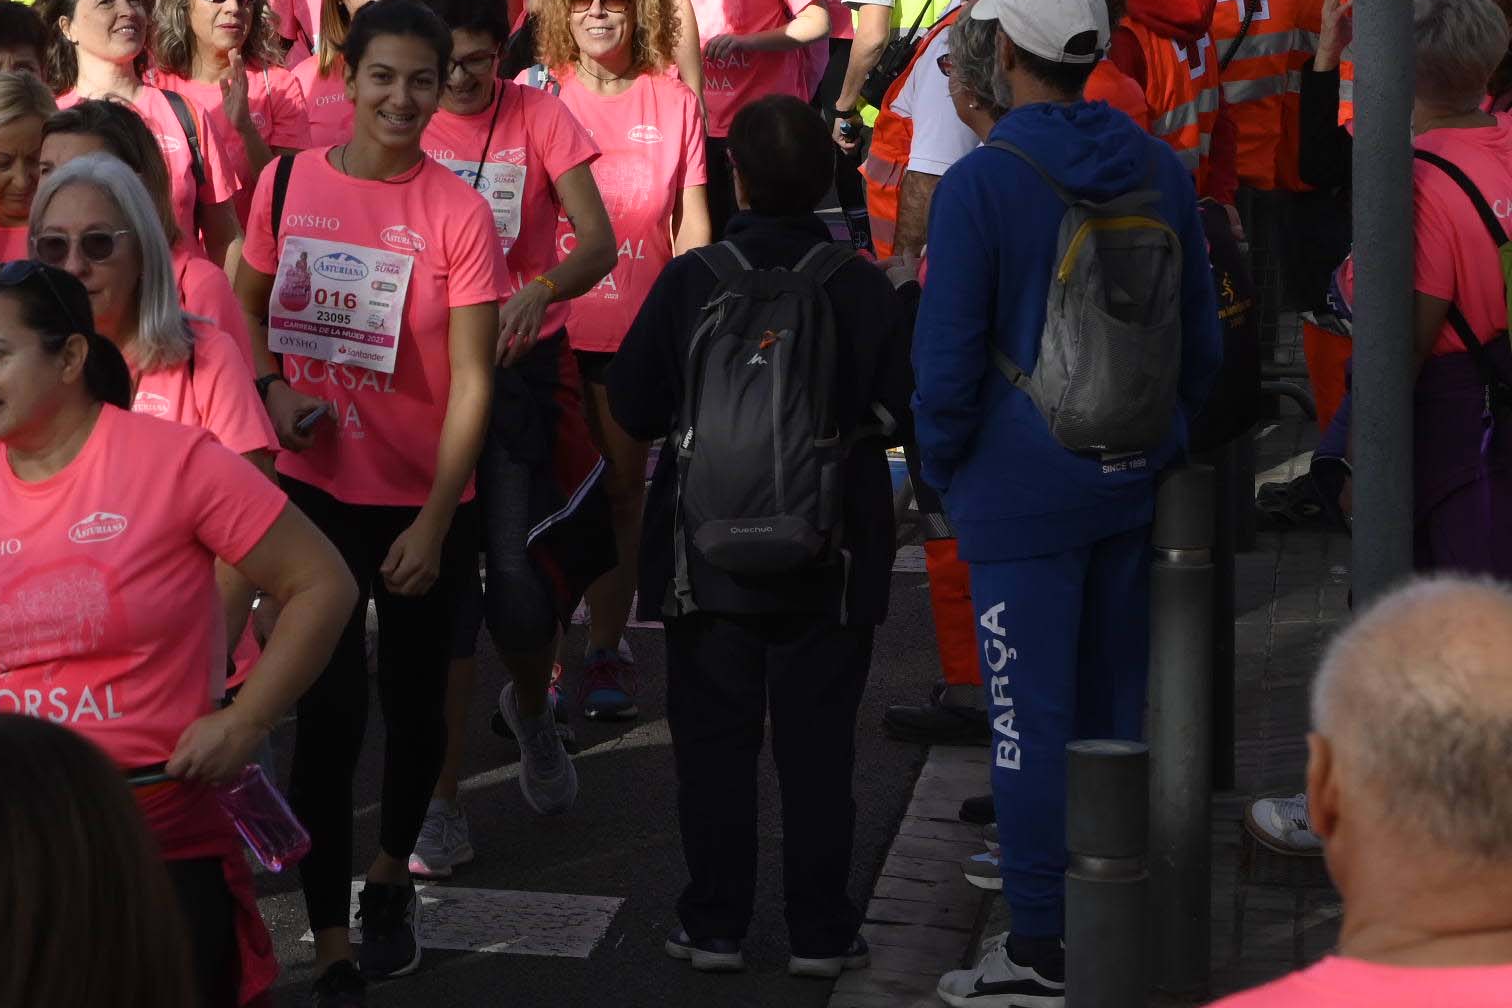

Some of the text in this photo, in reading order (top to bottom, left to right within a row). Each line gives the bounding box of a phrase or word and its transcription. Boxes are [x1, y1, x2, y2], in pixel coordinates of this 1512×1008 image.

[286, 214, 341, 231] OYSHO
[317, 262, 365, 278] ASTURIANA
[374, 264, 400, 276] SUMA
[314, 288, 358, 310] 016
[316, 310, 352, 325] 23095
[283, 320, 318, 333] CARRERA
[318, 326, 330, 335] DE
[331, 327, 341, 336] LA
[341, 329, 366, 342] MUJER
[279, 335, 385, 362] OYSHO Santander
[1102, 462, 1128, 474] SINCE
[74, 522, 123, 540] ASTURIANA
[729, 525, 773, 535] Quechua
[979, 600, 1022, 771] BARÇA
